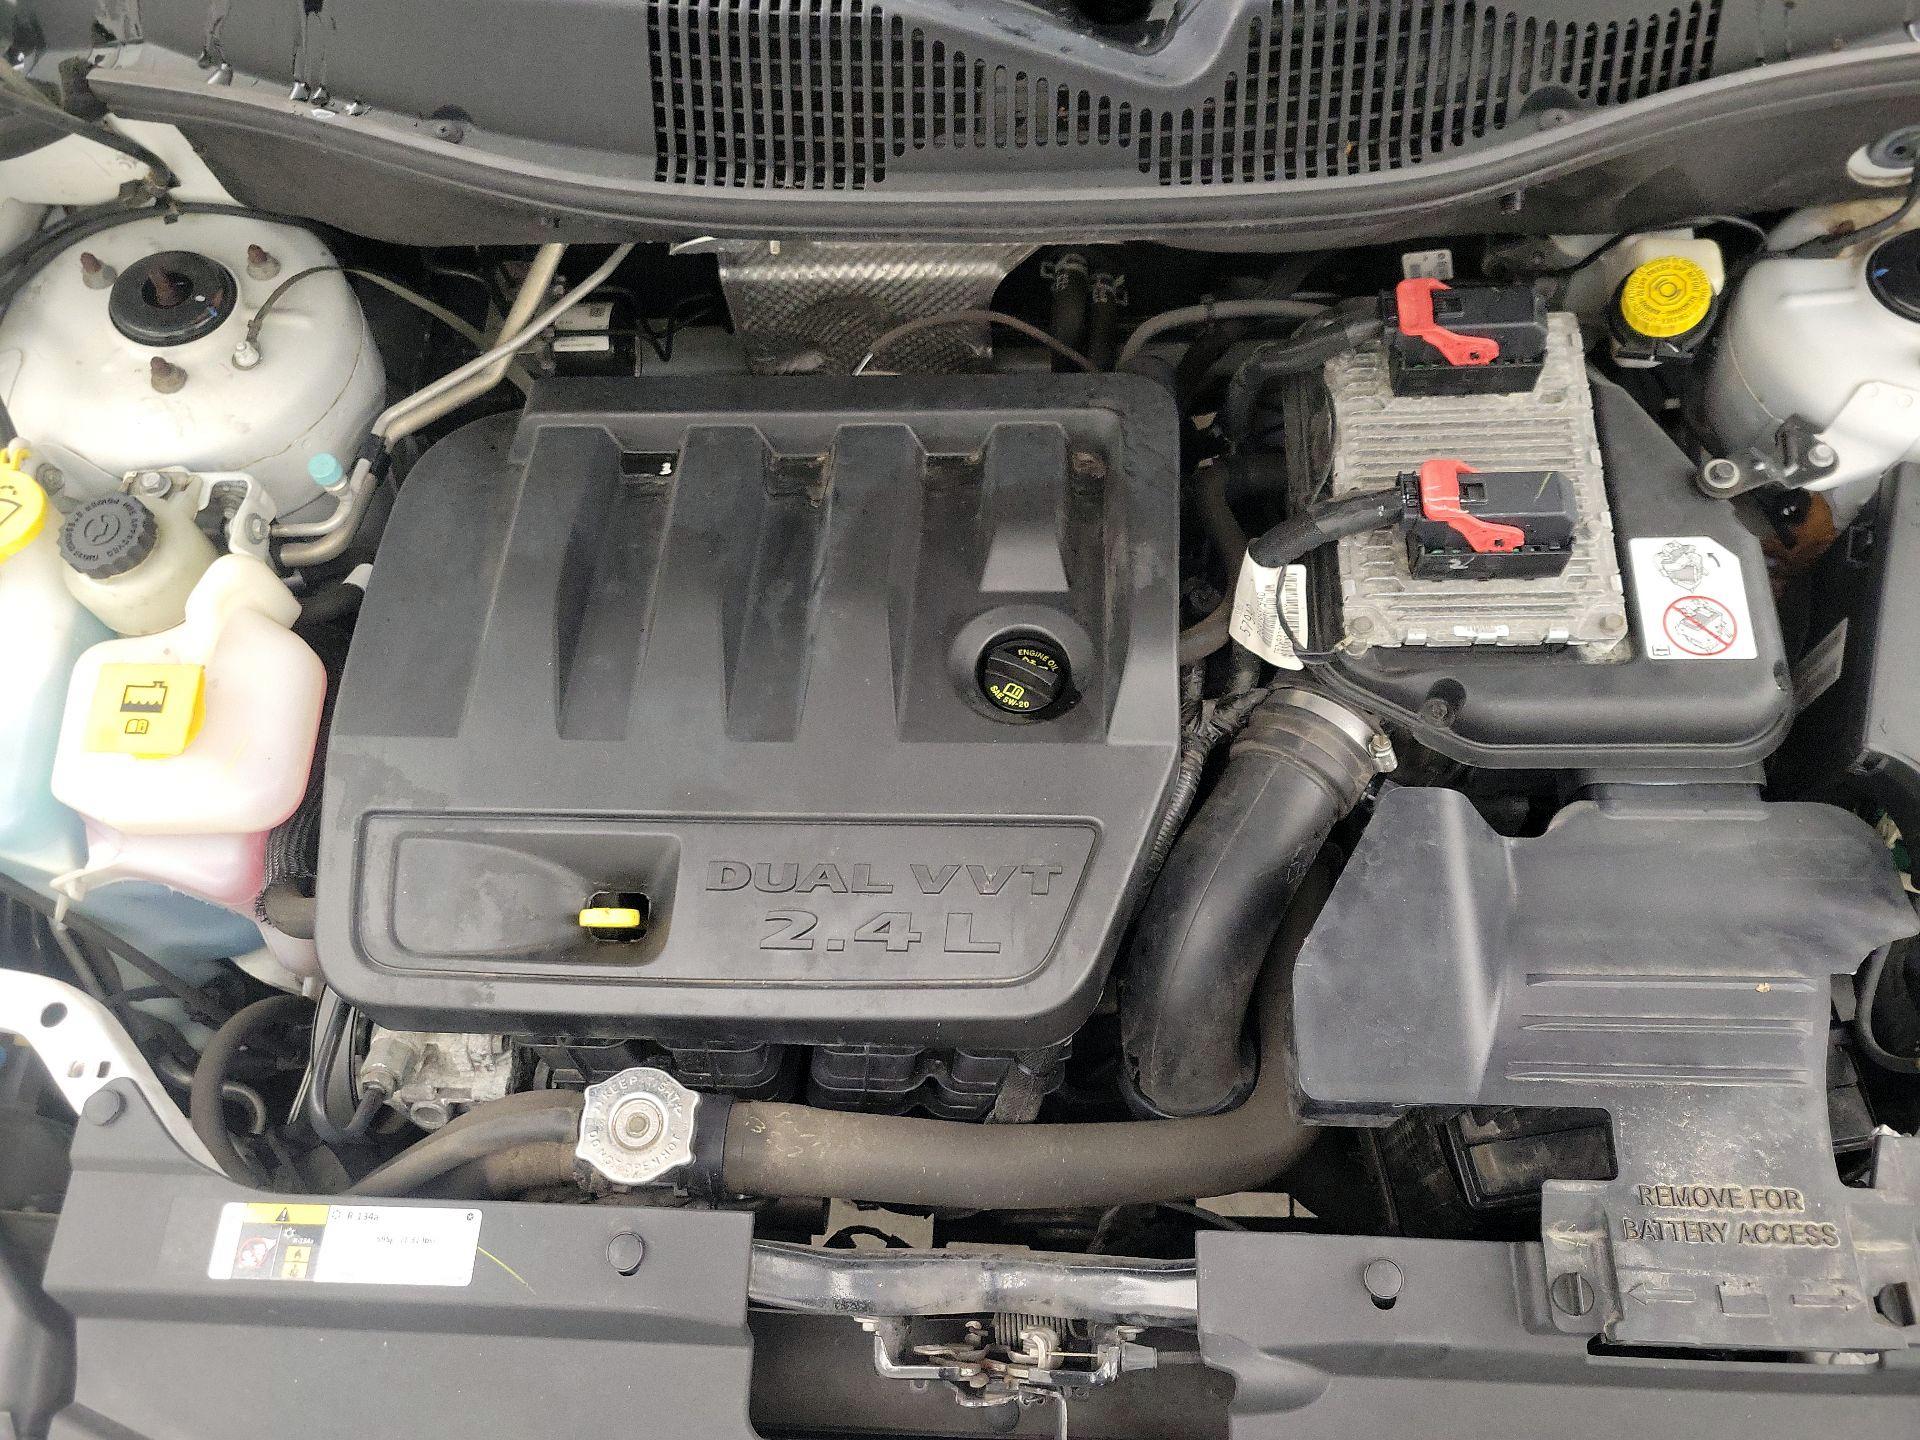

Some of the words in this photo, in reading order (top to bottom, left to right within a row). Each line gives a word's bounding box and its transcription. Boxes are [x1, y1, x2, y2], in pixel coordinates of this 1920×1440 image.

[1017, 648, 1050, 662] ENGINE
[1047, 659, 1059, 672] OIL
[989, 685, 1005, 700] SAE
[1002, 696, 1030, 709] 5W-20
[706, 860, 894, 894] DUAL
[909, 863, 1063, 896] VVT
[759, 909, 923, 953] 2.4
[943, 912, 1001, 954] L
[1637, 1183, 1745, 1210] REMOVE
[1750, 1187, 1805, 1212] FOR
[1622, 1218, 1729, 1244] BATTERY
[1737, 1222, 1841, 1248] ACCESS
